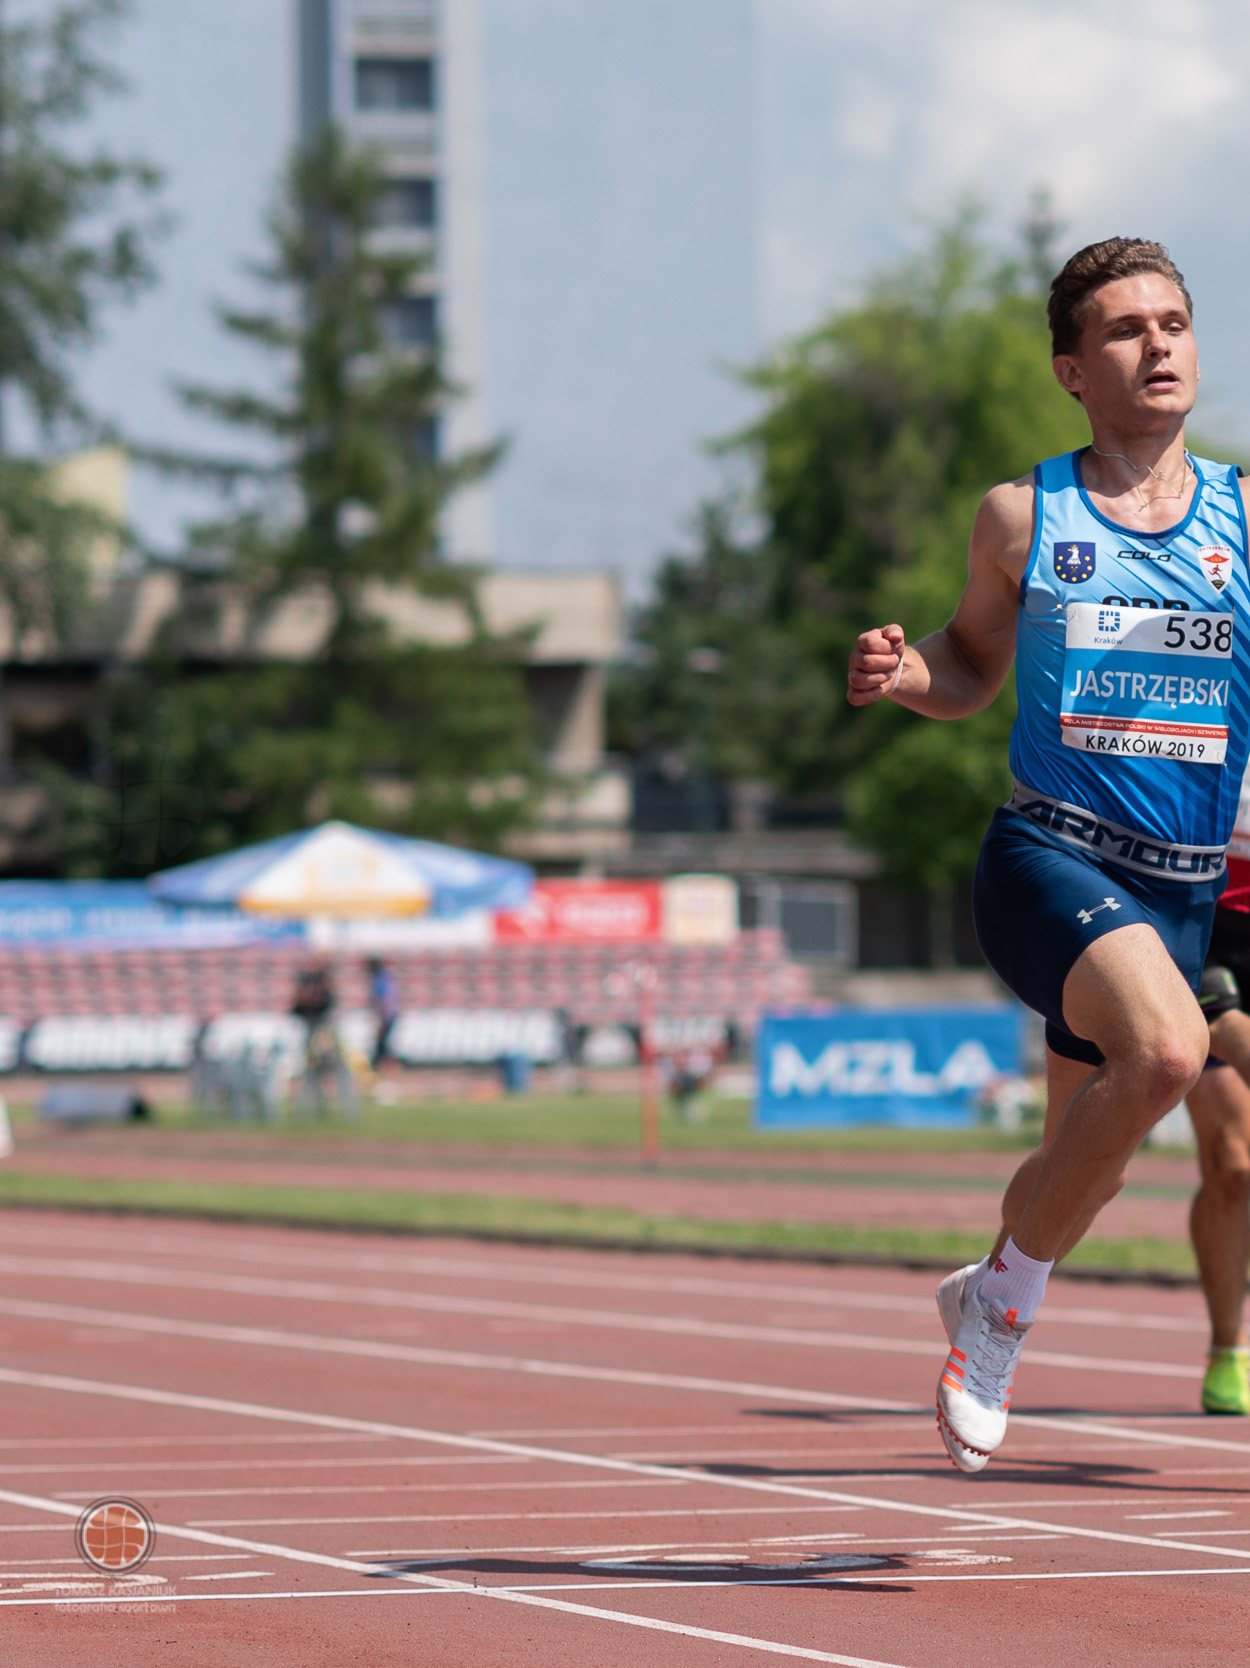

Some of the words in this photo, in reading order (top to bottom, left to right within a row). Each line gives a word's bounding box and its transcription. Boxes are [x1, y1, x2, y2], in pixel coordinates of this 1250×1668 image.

[1094, 637, 1123, 646] Kraków
[1164, 616, 1232, 652] 538
[1070, 670, 1229, 708] JASTRZĘBSKI
[1085, 735, 1162, 754] KRAKÓW
[1166, 742, 1205, 758] 2019
[1017, 799, 1225, 873] ARMOUR
[770, 1039, 998, 1097] MZLA
